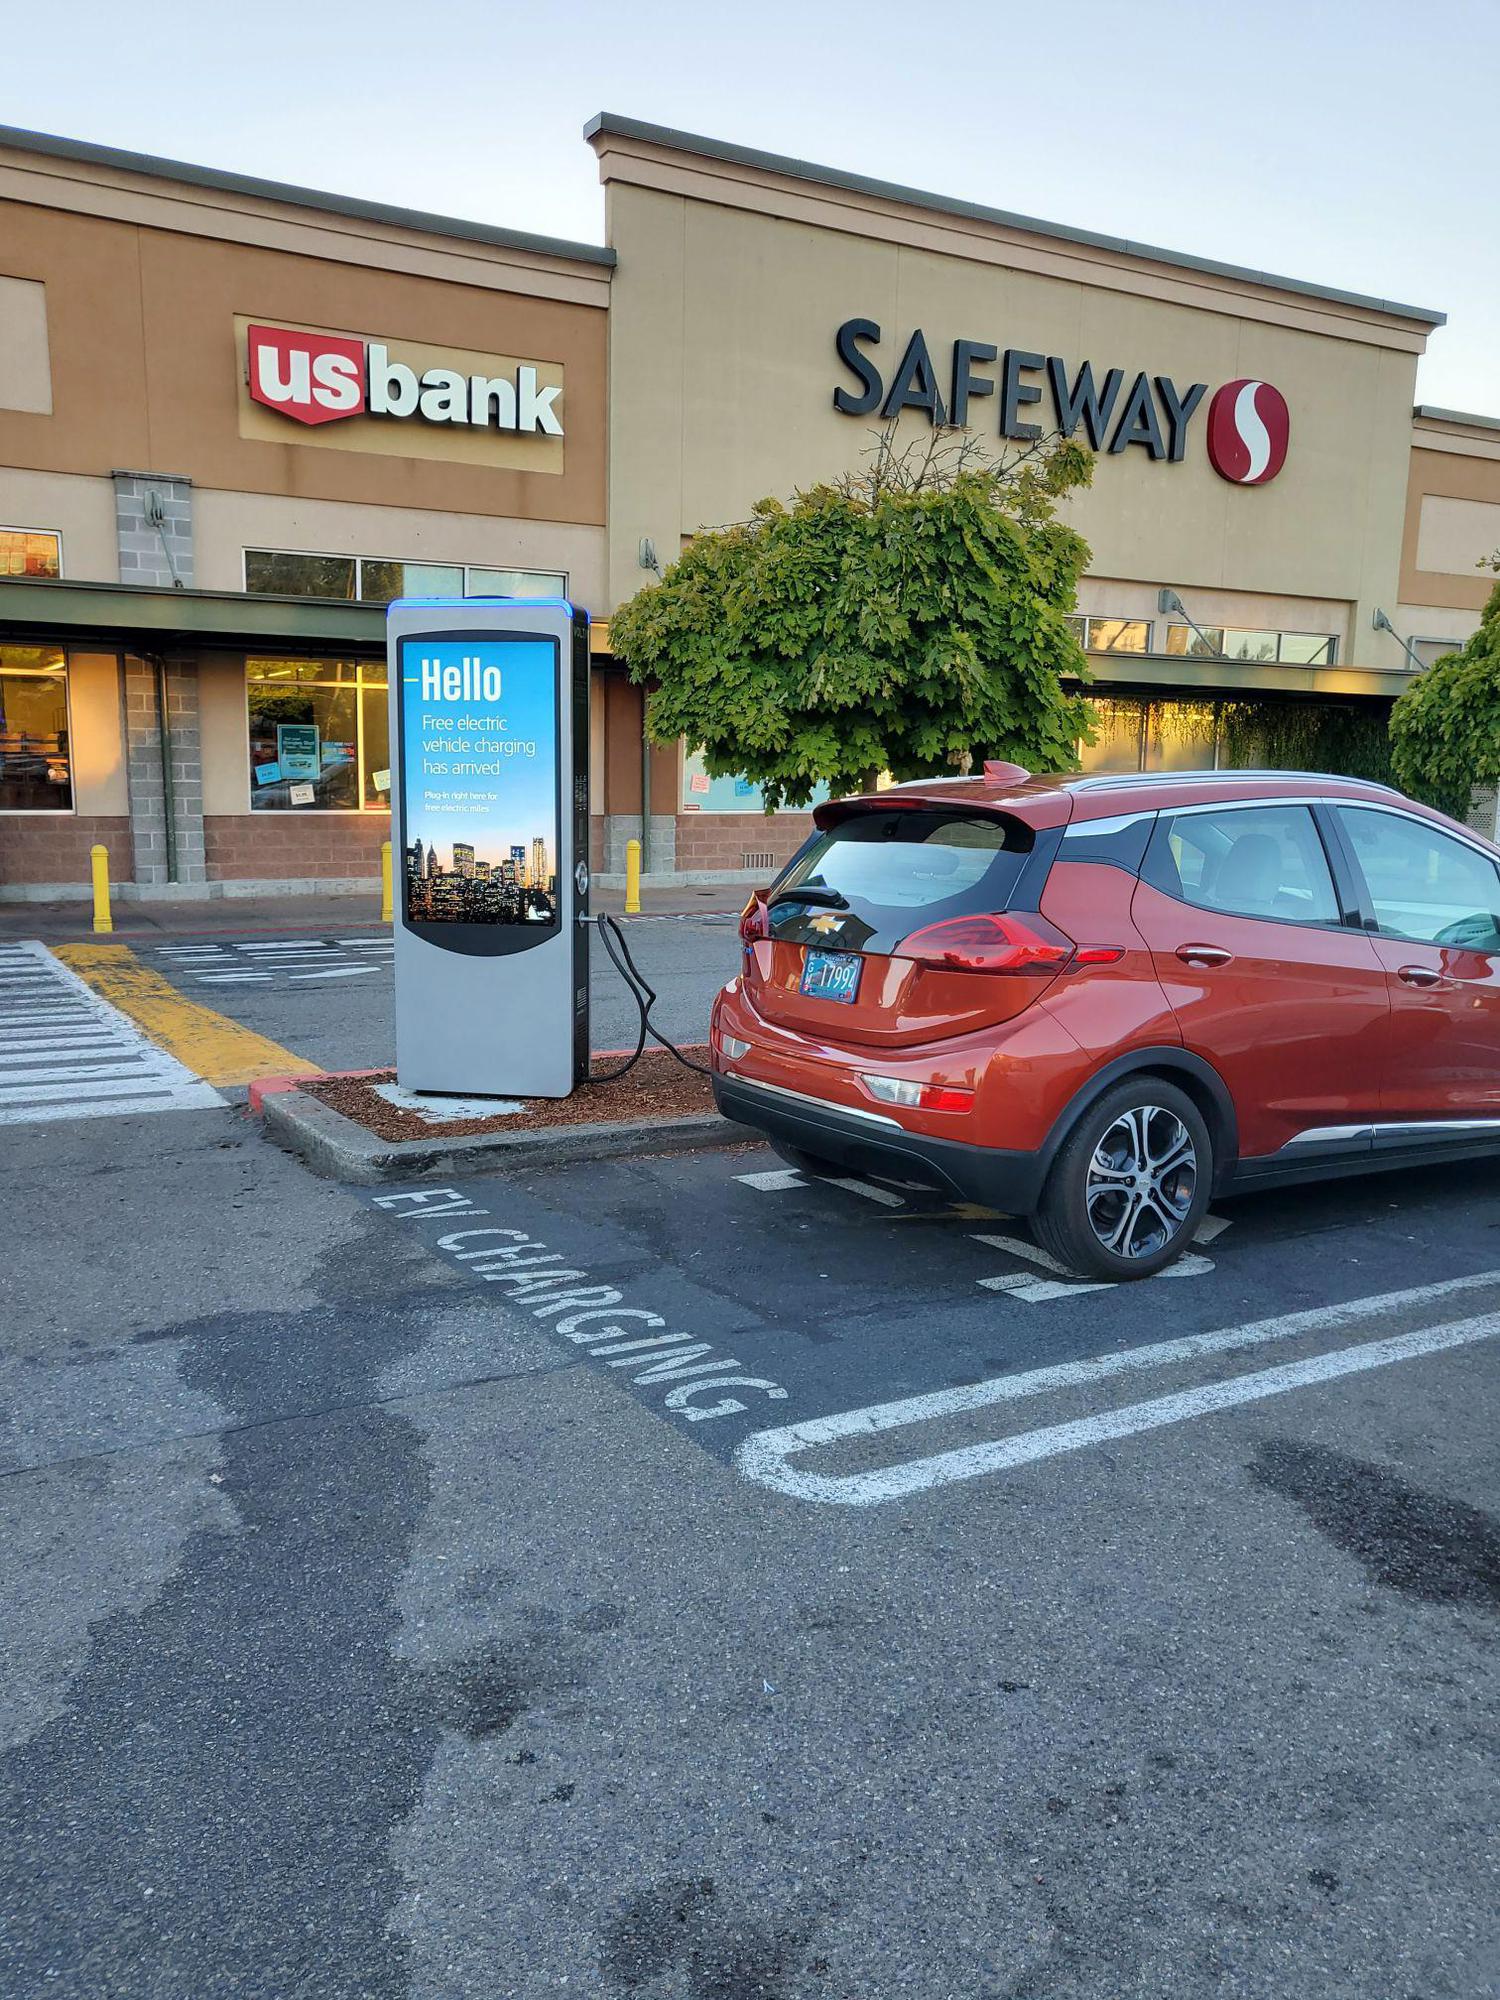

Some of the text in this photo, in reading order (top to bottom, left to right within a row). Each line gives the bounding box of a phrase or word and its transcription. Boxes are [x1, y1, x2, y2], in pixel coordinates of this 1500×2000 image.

[257, 343, 565, 436] us bank
[833, 318, 1209, 463] SAFEWAY
[421, 657, 502, 702] Hello
[422, 713, 508, 731] Free electric
[422, 736, 537, 758] vehicle charging
[422, 758, 500, 775] has arrived
[371, 1187, 490, 1219] EV
[436, 1228, 789, 1422] CHARGING
